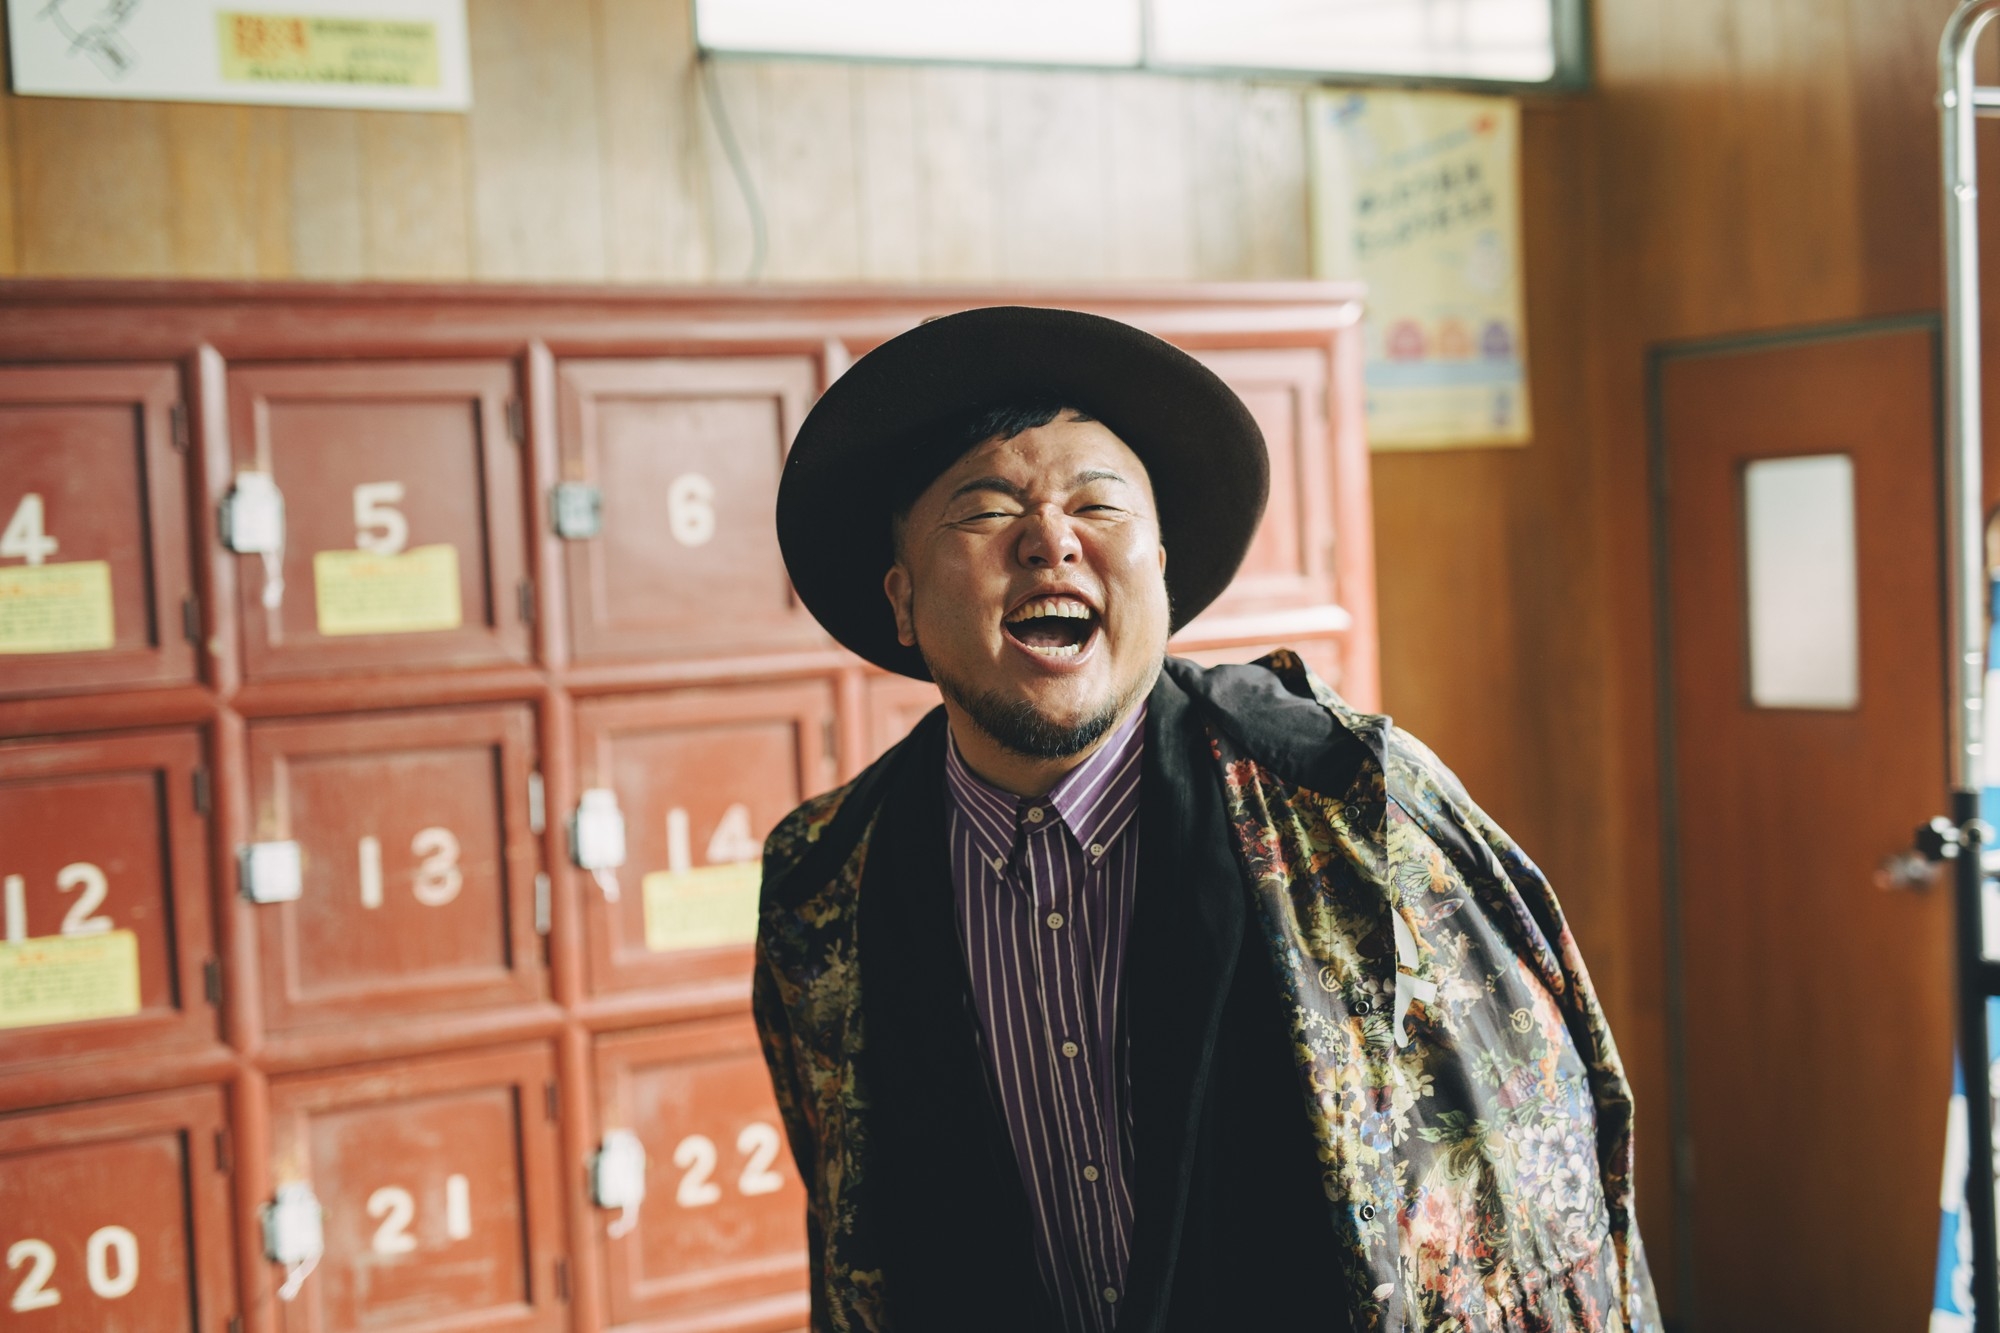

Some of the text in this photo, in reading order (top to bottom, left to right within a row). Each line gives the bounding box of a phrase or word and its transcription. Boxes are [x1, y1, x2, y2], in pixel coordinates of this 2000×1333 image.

[0, 494, 58, 565] 4
[353, 481, 408, 555] 5
[667, 472, 716, 547] 6
[359, 825, 463, 909] 13
[666, 804, 764, 874] 14
[3, 861, 114, 943] 12
[673, 1121, 784, 1206] 22
[366, 1173, 472, 1255] 21
[6, 1225, 139, 1312] 20
